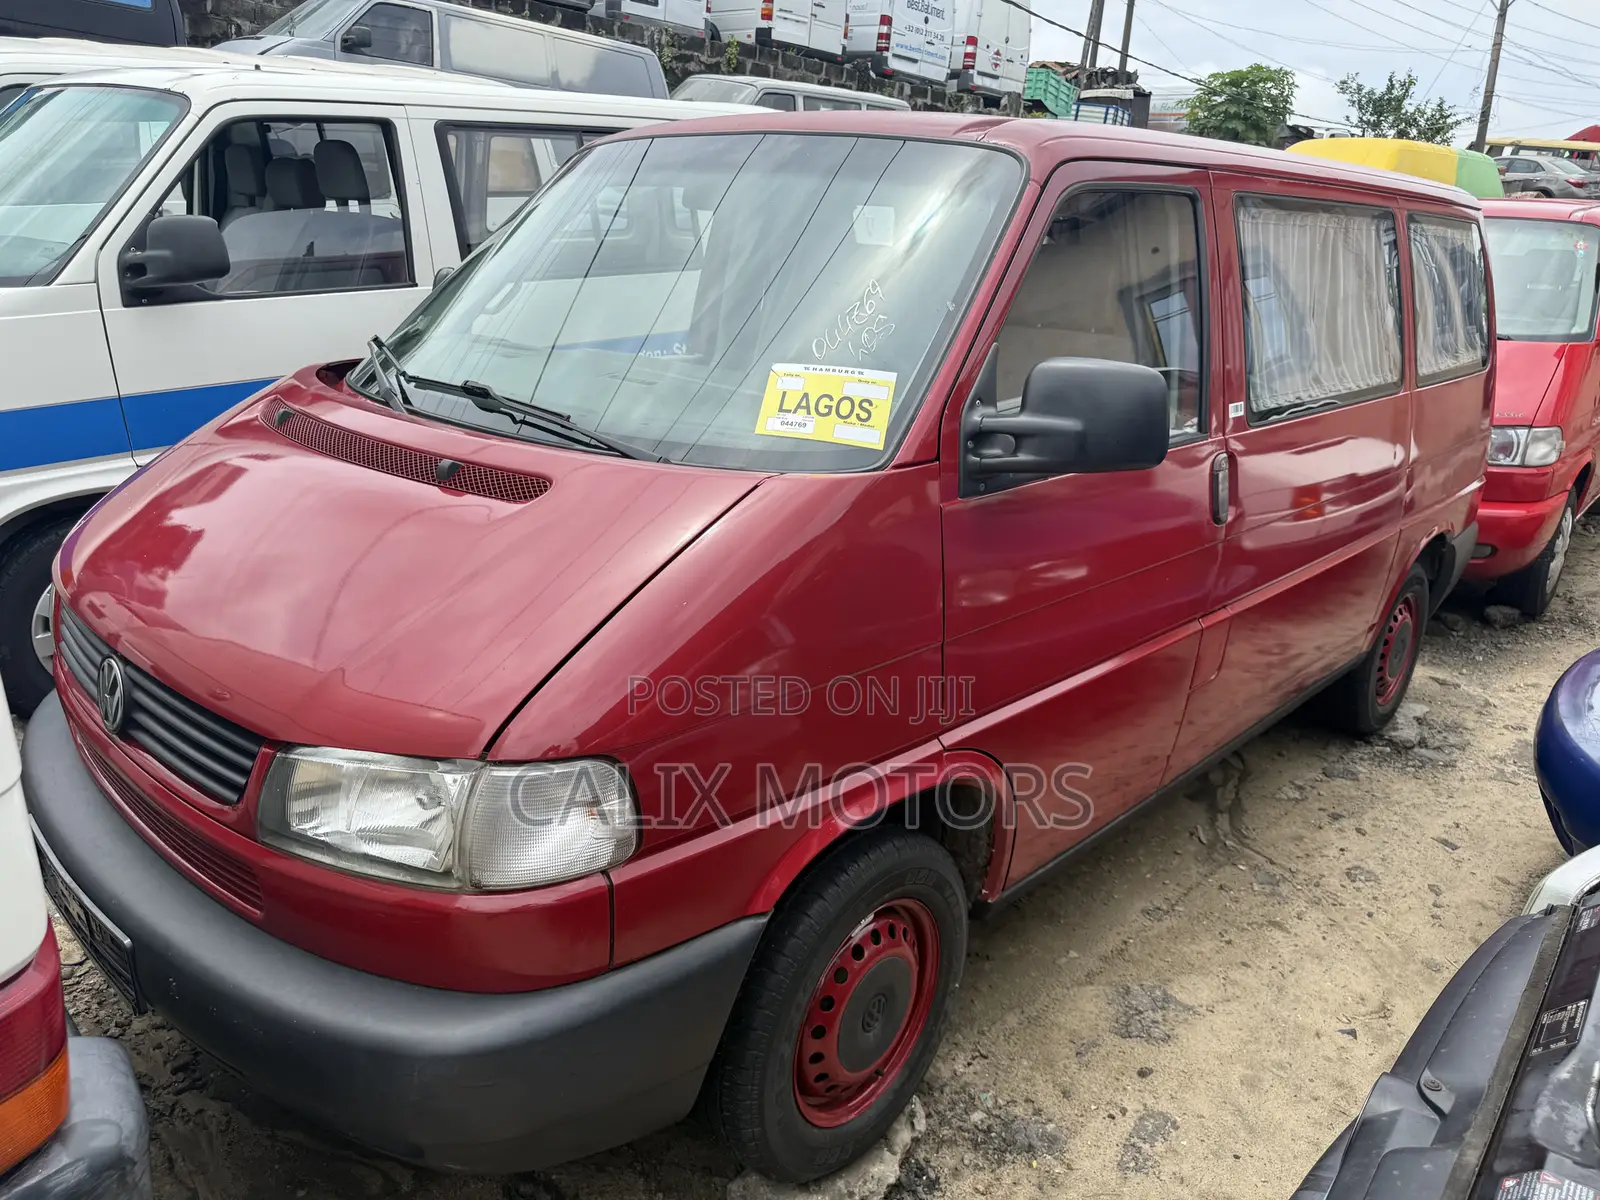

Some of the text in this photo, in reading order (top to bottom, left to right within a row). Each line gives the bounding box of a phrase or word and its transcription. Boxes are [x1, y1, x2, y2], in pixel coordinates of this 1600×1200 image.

[812, 366, 856, 375] HAMBURG
[777, 390, 874, 423] LAGOS
[780, 420, 807, 429] 044769
